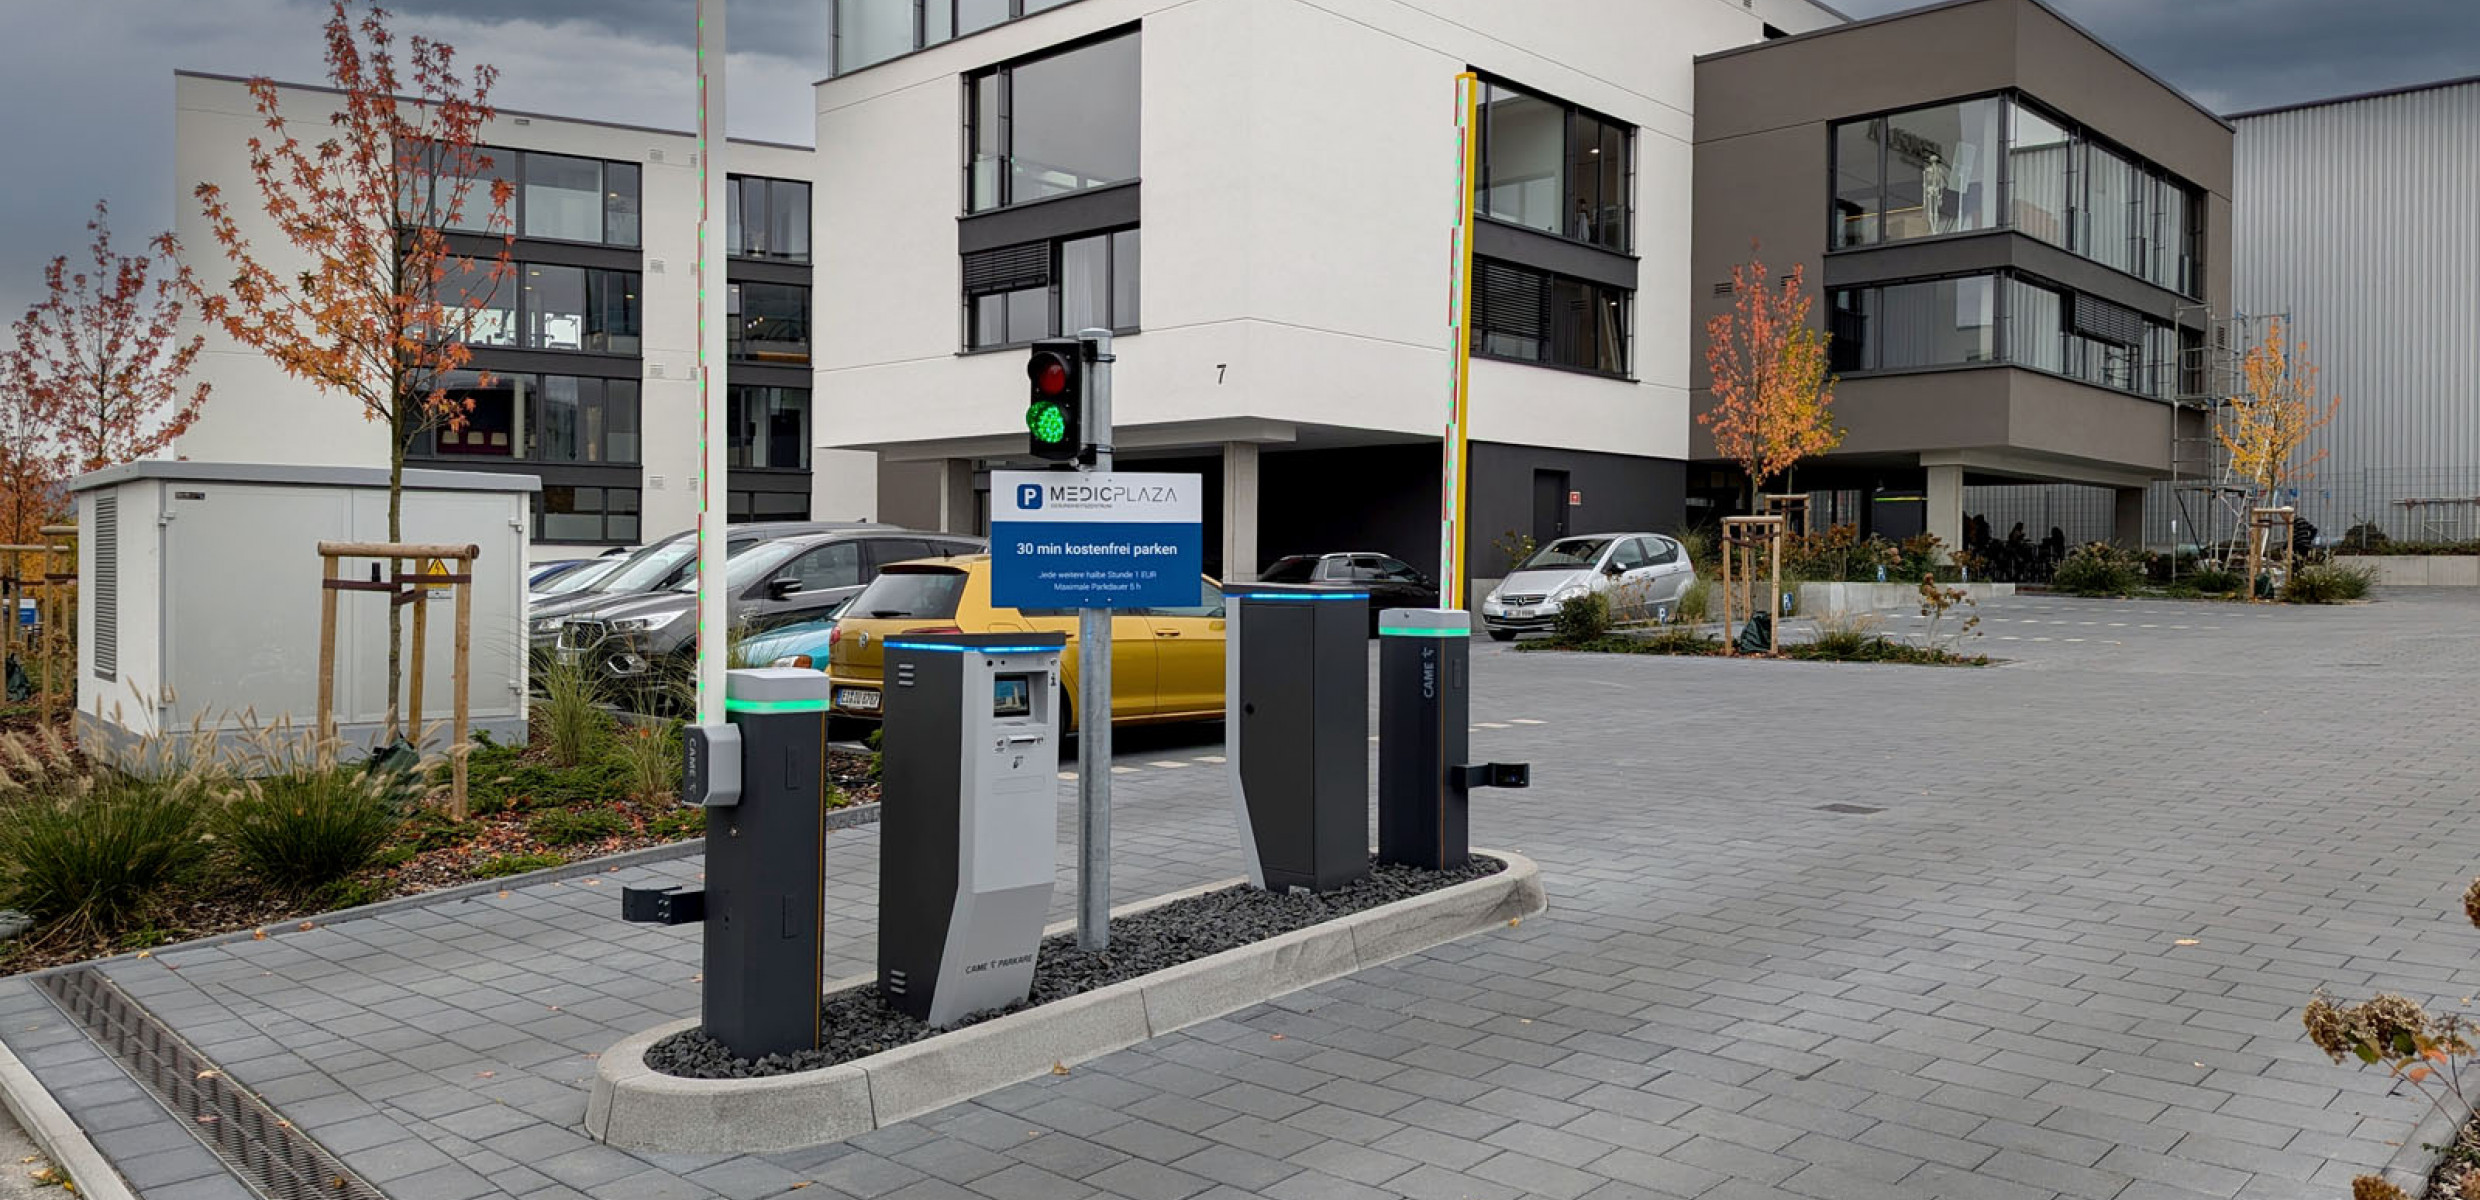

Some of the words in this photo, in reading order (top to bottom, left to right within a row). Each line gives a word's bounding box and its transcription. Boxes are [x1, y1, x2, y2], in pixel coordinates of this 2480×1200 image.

[1216, 363, 1227, 385] 7
[1050, 486, 1177, 502] MEDICPLAZA
[1016, 542, 1033, 555] 30
[1036, 542, 1062, 555] min
[1065, 542, 1131, 555] kostenfrei
[1134, 542, 1177, 558] parken
[1038, 571, 1057, 579] Jede
[1058, 571, 1085, 579] weitere
[1086, 571, 1106, 579] halbe
[1107, 571, 1133, 579] Stunde
[1141, 571, 1157, 579] EUR
[1054, 583, 1090, 591] Maximale
[1091, 583, 1128, 591] Parkdauer
[1423, 662, 1435, 698] CAME
[689, 738, 697, 778] CAME
[966, 963, 988, 974] CAME
[998, 954, 1032, 968] PARKARE
